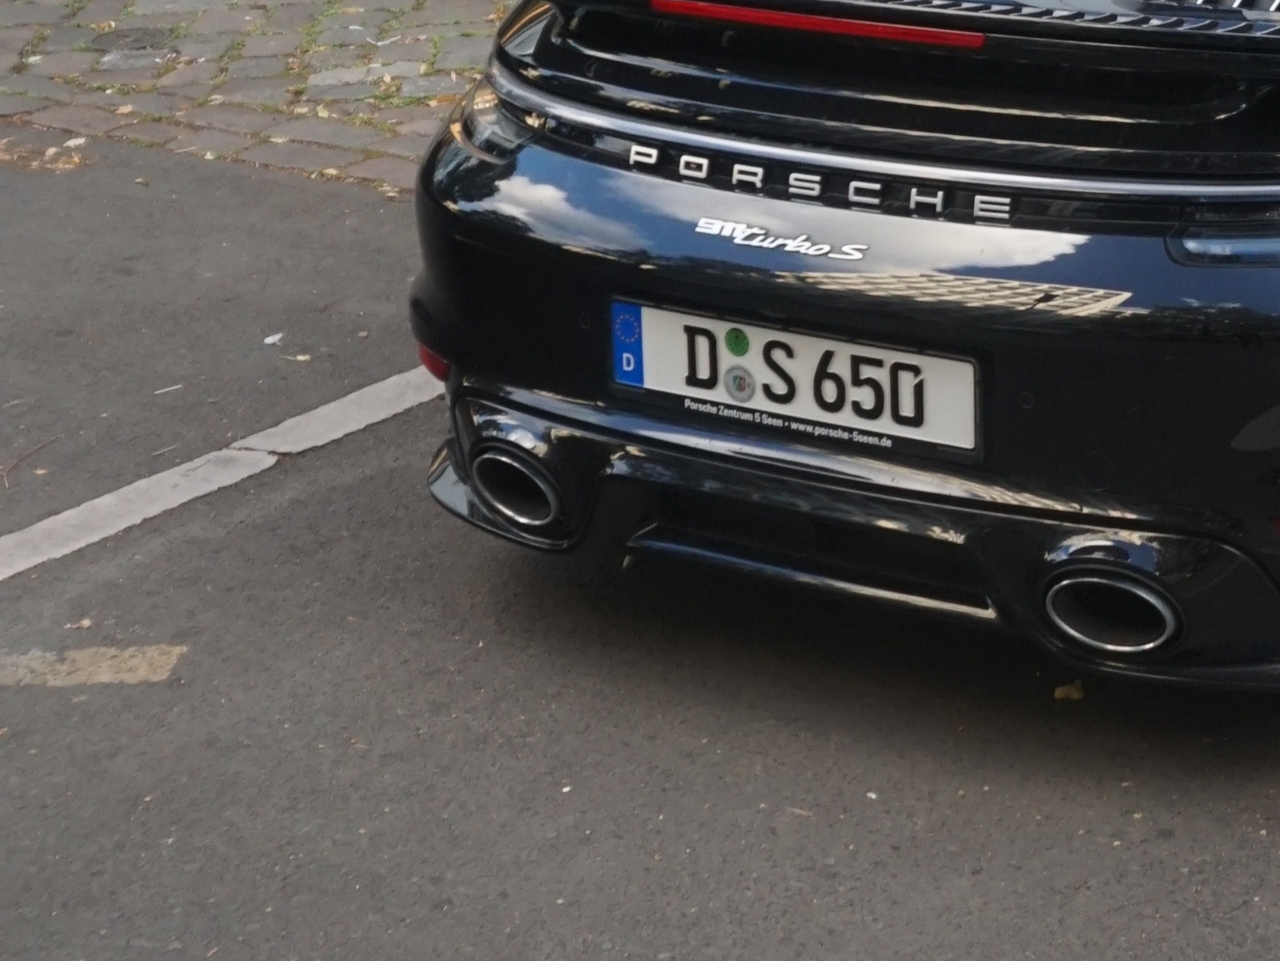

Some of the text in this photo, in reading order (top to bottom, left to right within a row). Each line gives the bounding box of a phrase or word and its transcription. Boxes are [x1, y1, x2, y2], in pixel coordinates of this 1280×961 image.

[630, 144, 1011, 220] PORSCHE
[695, 218, 747, 238] 911
[828, 244, 868, 260] S
[622, 353, 634, 371] D
[683, 325, 924, 428] D S 650
[684, 398, 892, 448] Porsche Zentrum 5 Seen www.porsche-5seen.de
